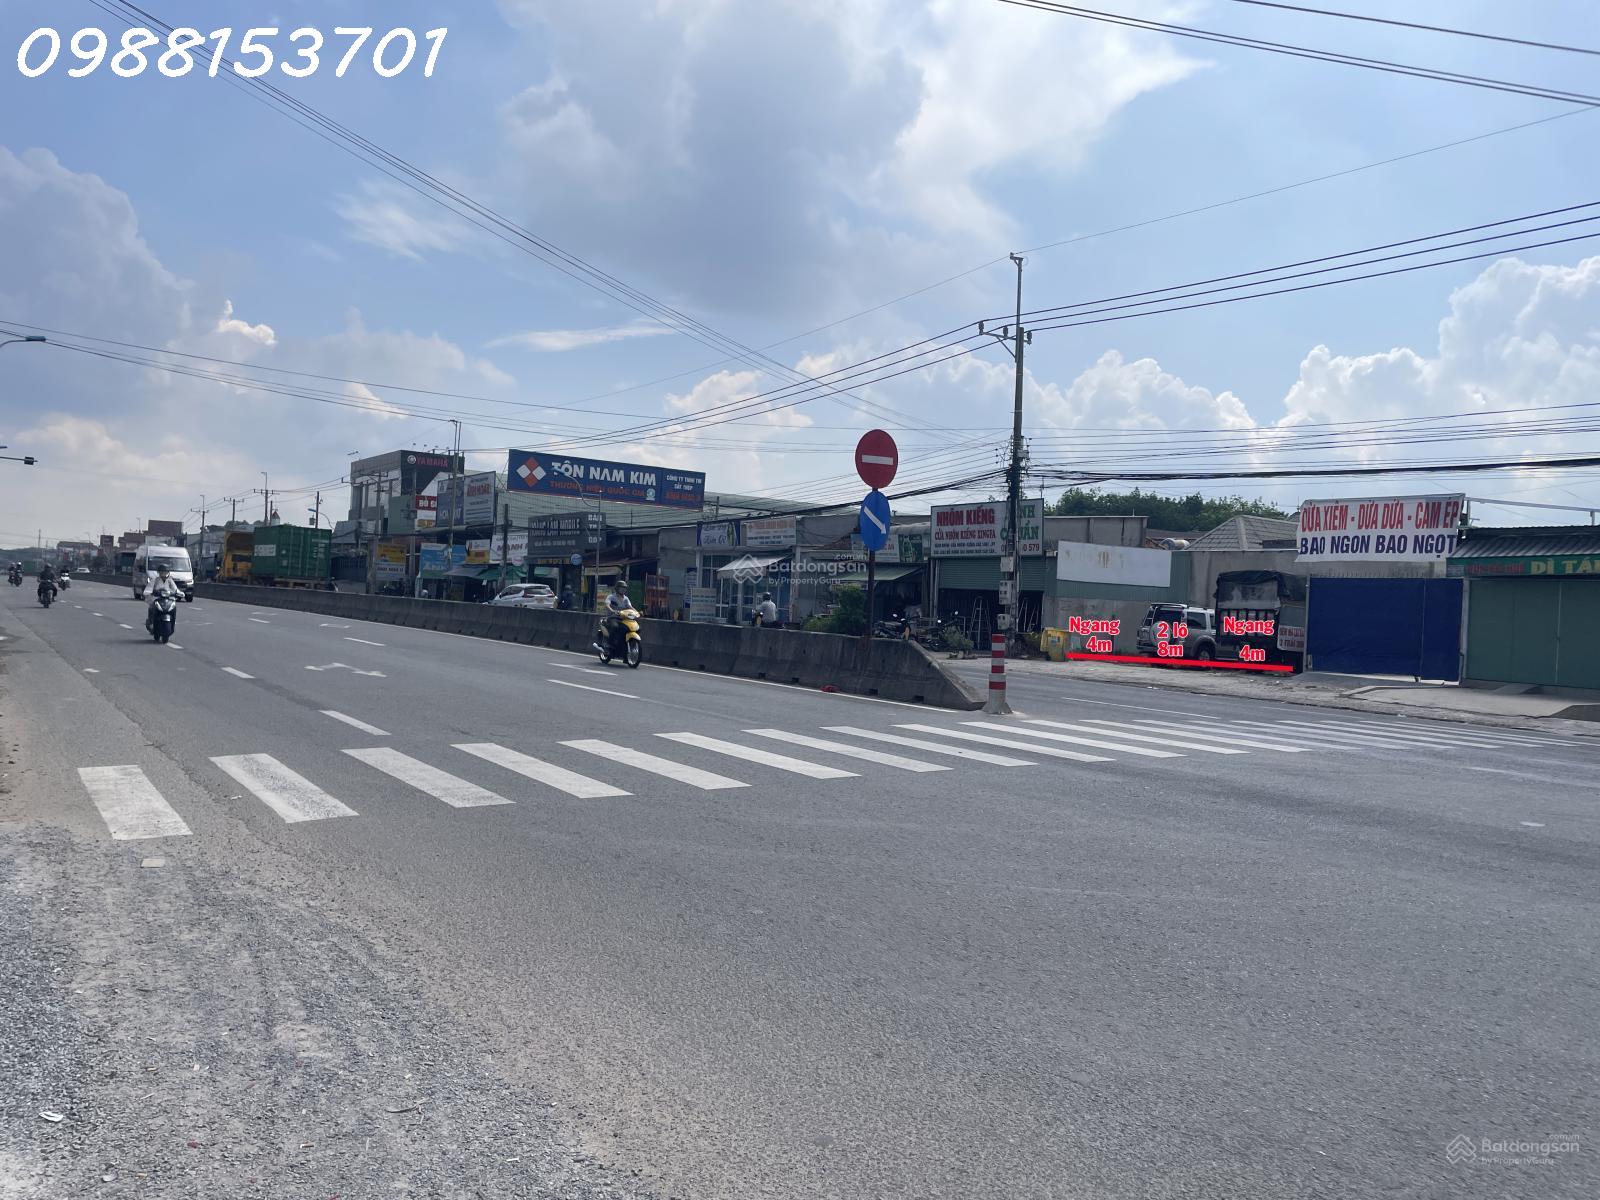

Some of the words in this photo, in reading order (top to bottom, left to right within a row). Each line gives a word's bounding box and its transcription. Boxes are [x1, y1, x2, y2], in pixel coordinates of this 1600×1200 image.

[416, 455, 448, 467] YAMAHA
[551, 460, 584, 479] TÔN
[589, 466, 625, 483] NAM
[630, 471, 657, 486] KIM
[936, 508, 964, 526] NHÔM
[966, 504, 995, 525] KIẾNG
[1323, 500, 1349, 531] XIÊM
[1415, 501, 1442, 529] CAM
[1443, 497, 1460, 529] ÉP
[977, 528, 996, 539] XINGFA
[1299, 537, 1326, 555] BAO
[1330, 535, 1371, 554] NGON
[1375, 534, 1408, 554] BAO
[1412, 534, 1458, 558] NGỌT
[1531, 557, 1554, 575] DÌ
